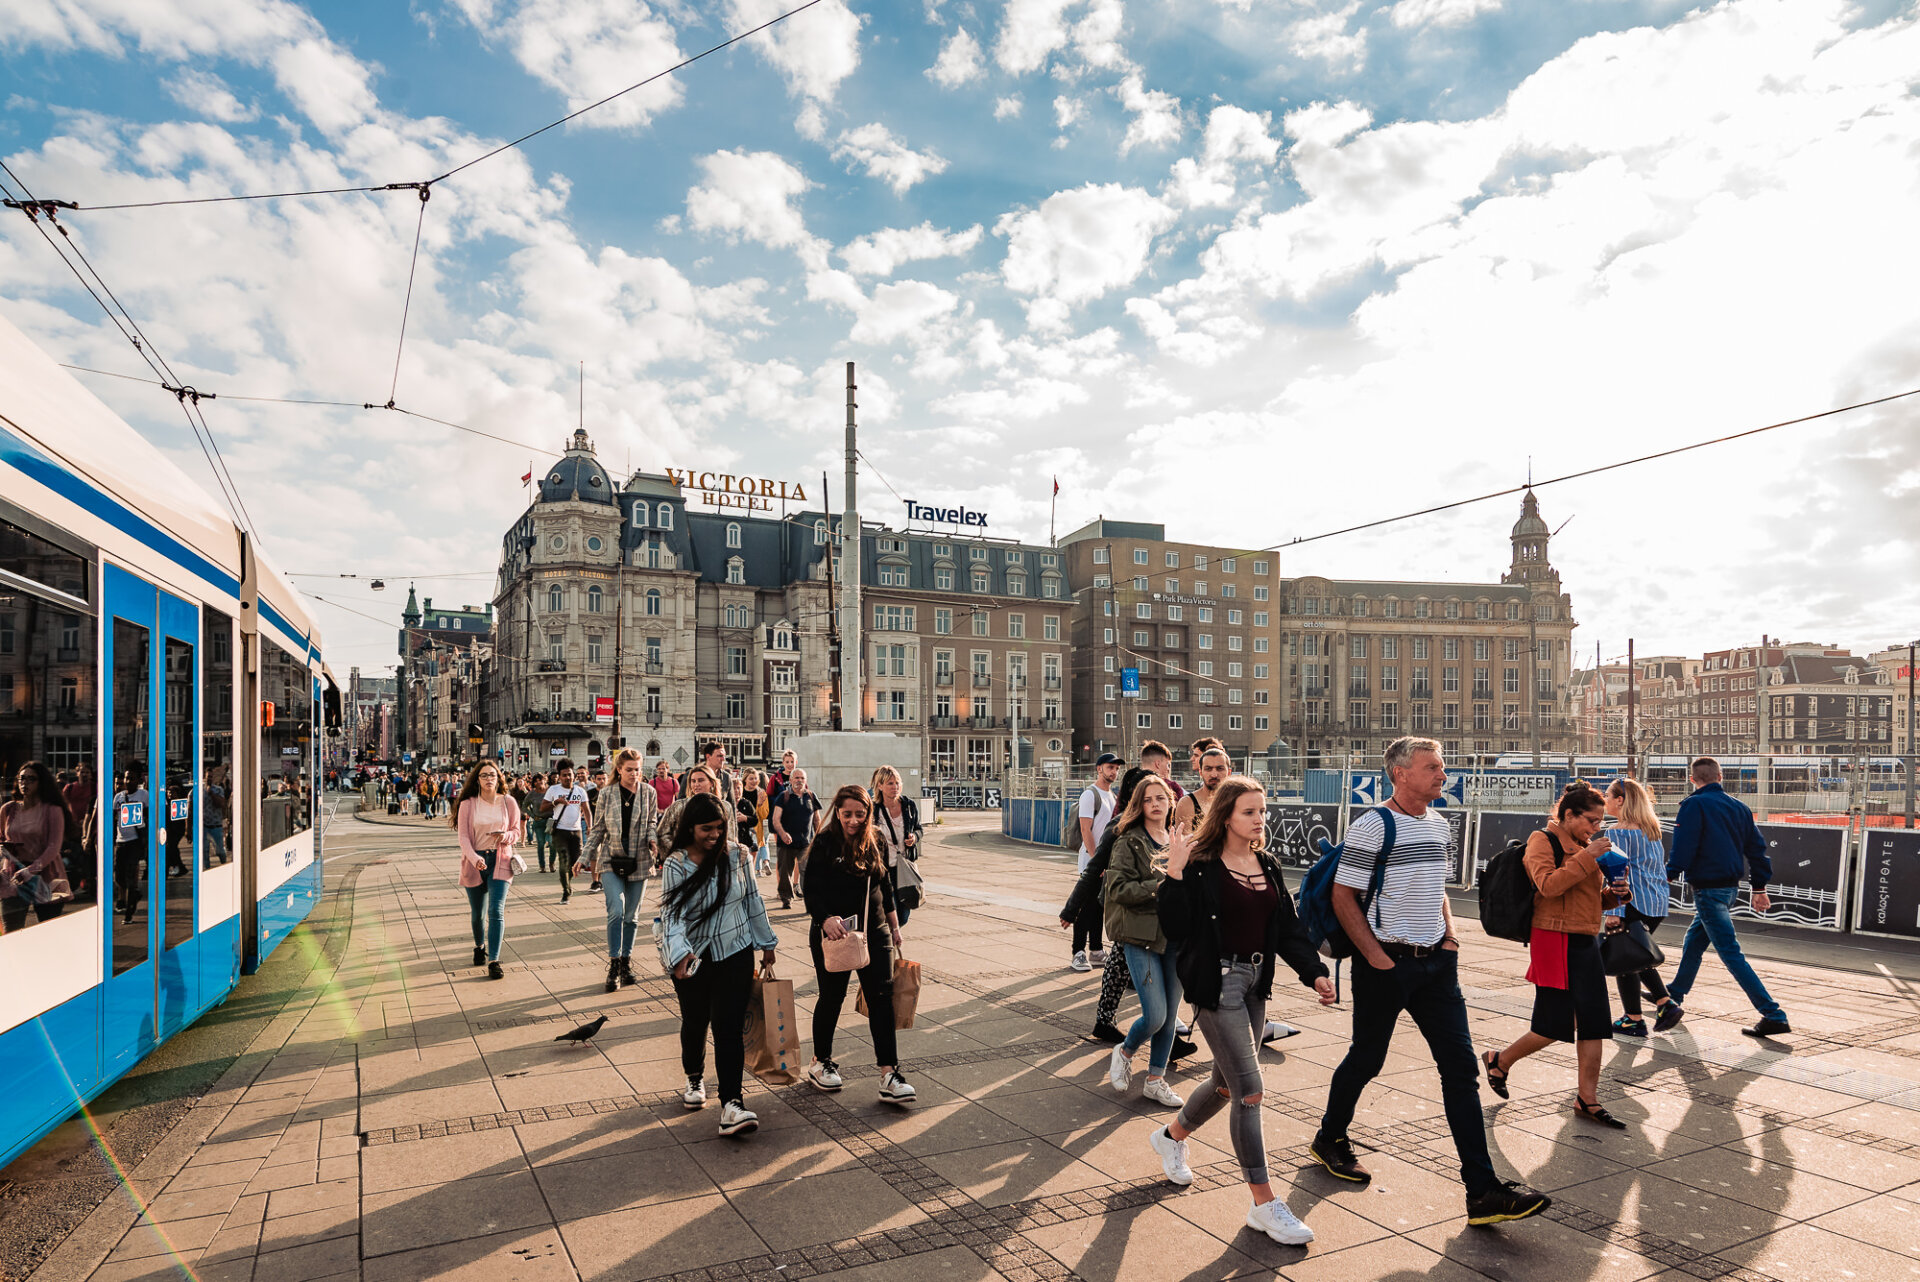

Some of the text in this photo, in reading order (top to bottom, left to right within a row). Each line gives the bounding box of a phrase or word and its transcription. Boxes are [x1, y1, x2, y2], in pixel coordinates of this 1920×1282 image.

[664, 467, 807, 501] VICTORIA
[702, 492, 773, 511] HOTEL
[903, 499, 988, 527] Travelex
[544, 570, 567, 578] HOTEL
[1162, 594, 1217, 606] Park Plaza Victoria
[1465, 777, 1553, 789] KNIPSCHEER
